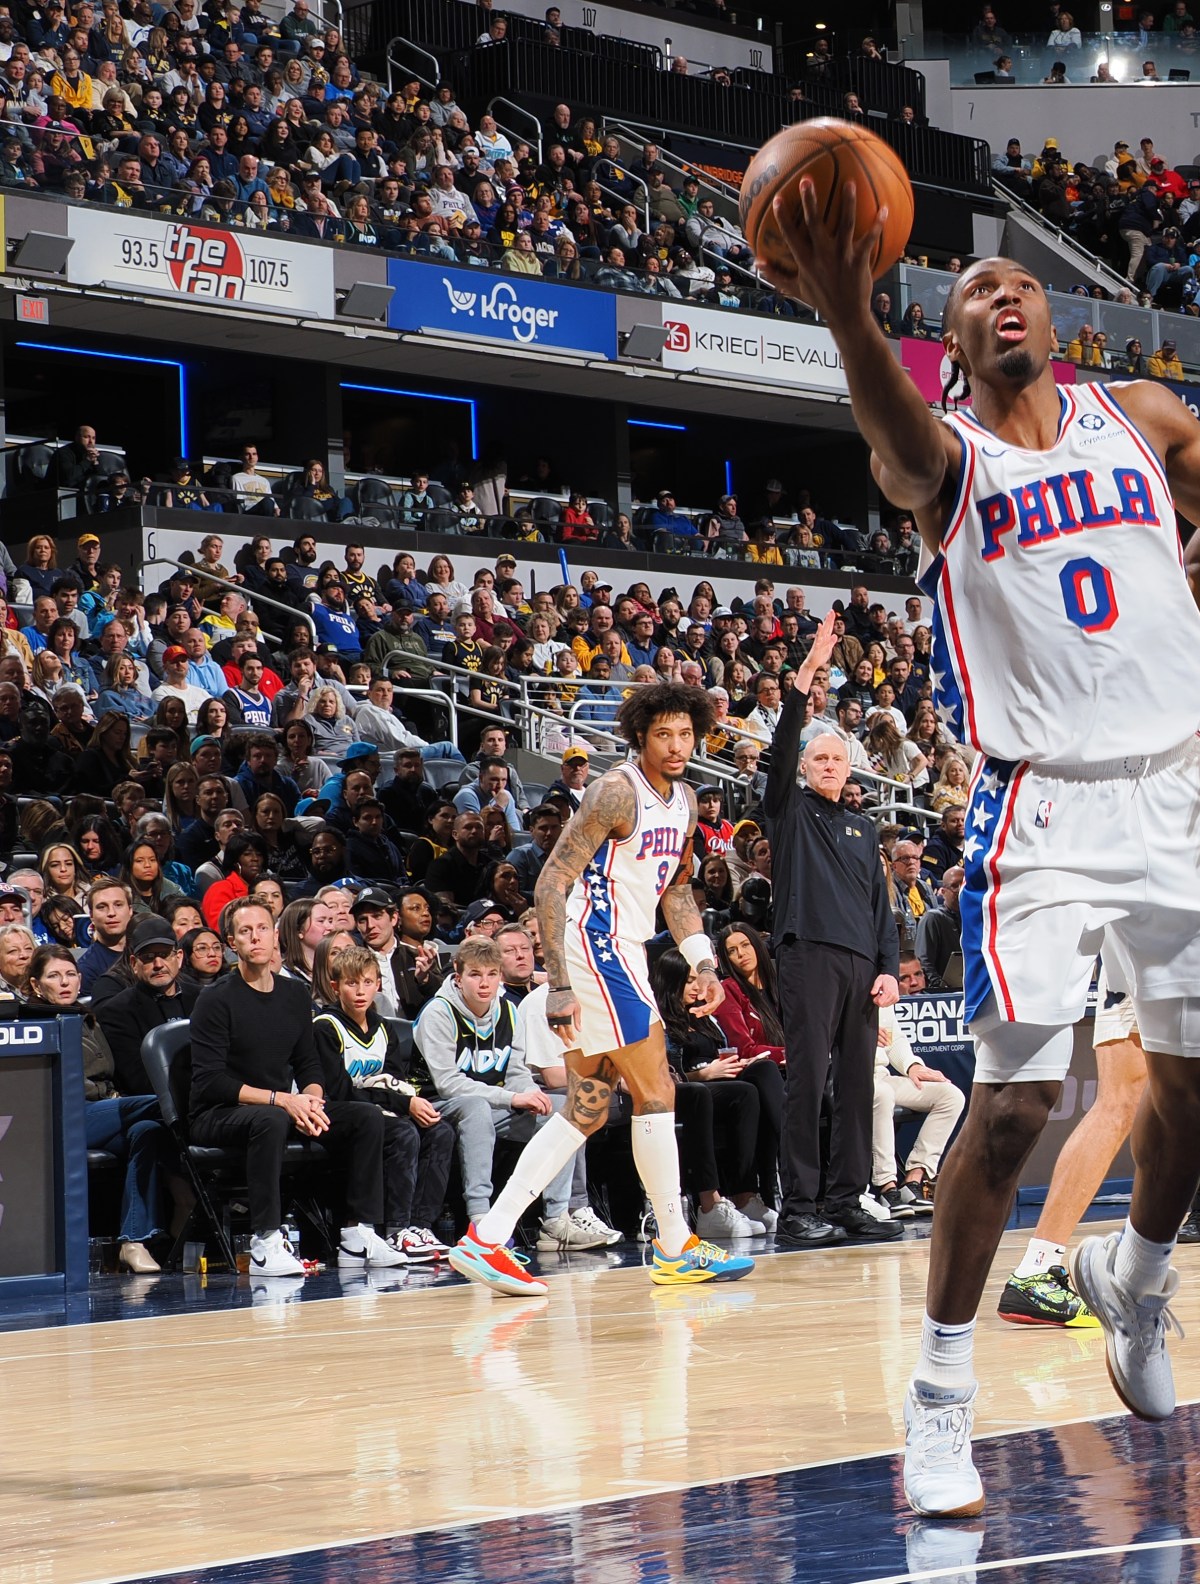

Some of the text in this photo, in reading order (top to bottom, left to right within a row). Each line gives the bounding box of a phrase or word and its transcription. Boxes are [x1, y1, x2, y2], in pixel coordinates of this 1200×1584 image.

[582, 7, 597, 28] 107
[968, 102, 975, 121] 7
[122, 223, 290, 288] 93.5 the 107.5
[178, 259, 245, 300] fan
[22, 299, 44, 320] EXIT
[481, 283, 559, 343] Kroger
[694, 332, 758, 357] KRIEG
[1078, 429, 1126, 448] crypto.com
[976, 468, 1162, 564] PHILA
[147, 532, 156, 560] 6
[1058, 556, 1120, 635] 0
[655, 860, 669, 895] 9
[456, 1045, 512, 1074] INDY
[913, 1045, 950, 1053] DEVELOPMENT
